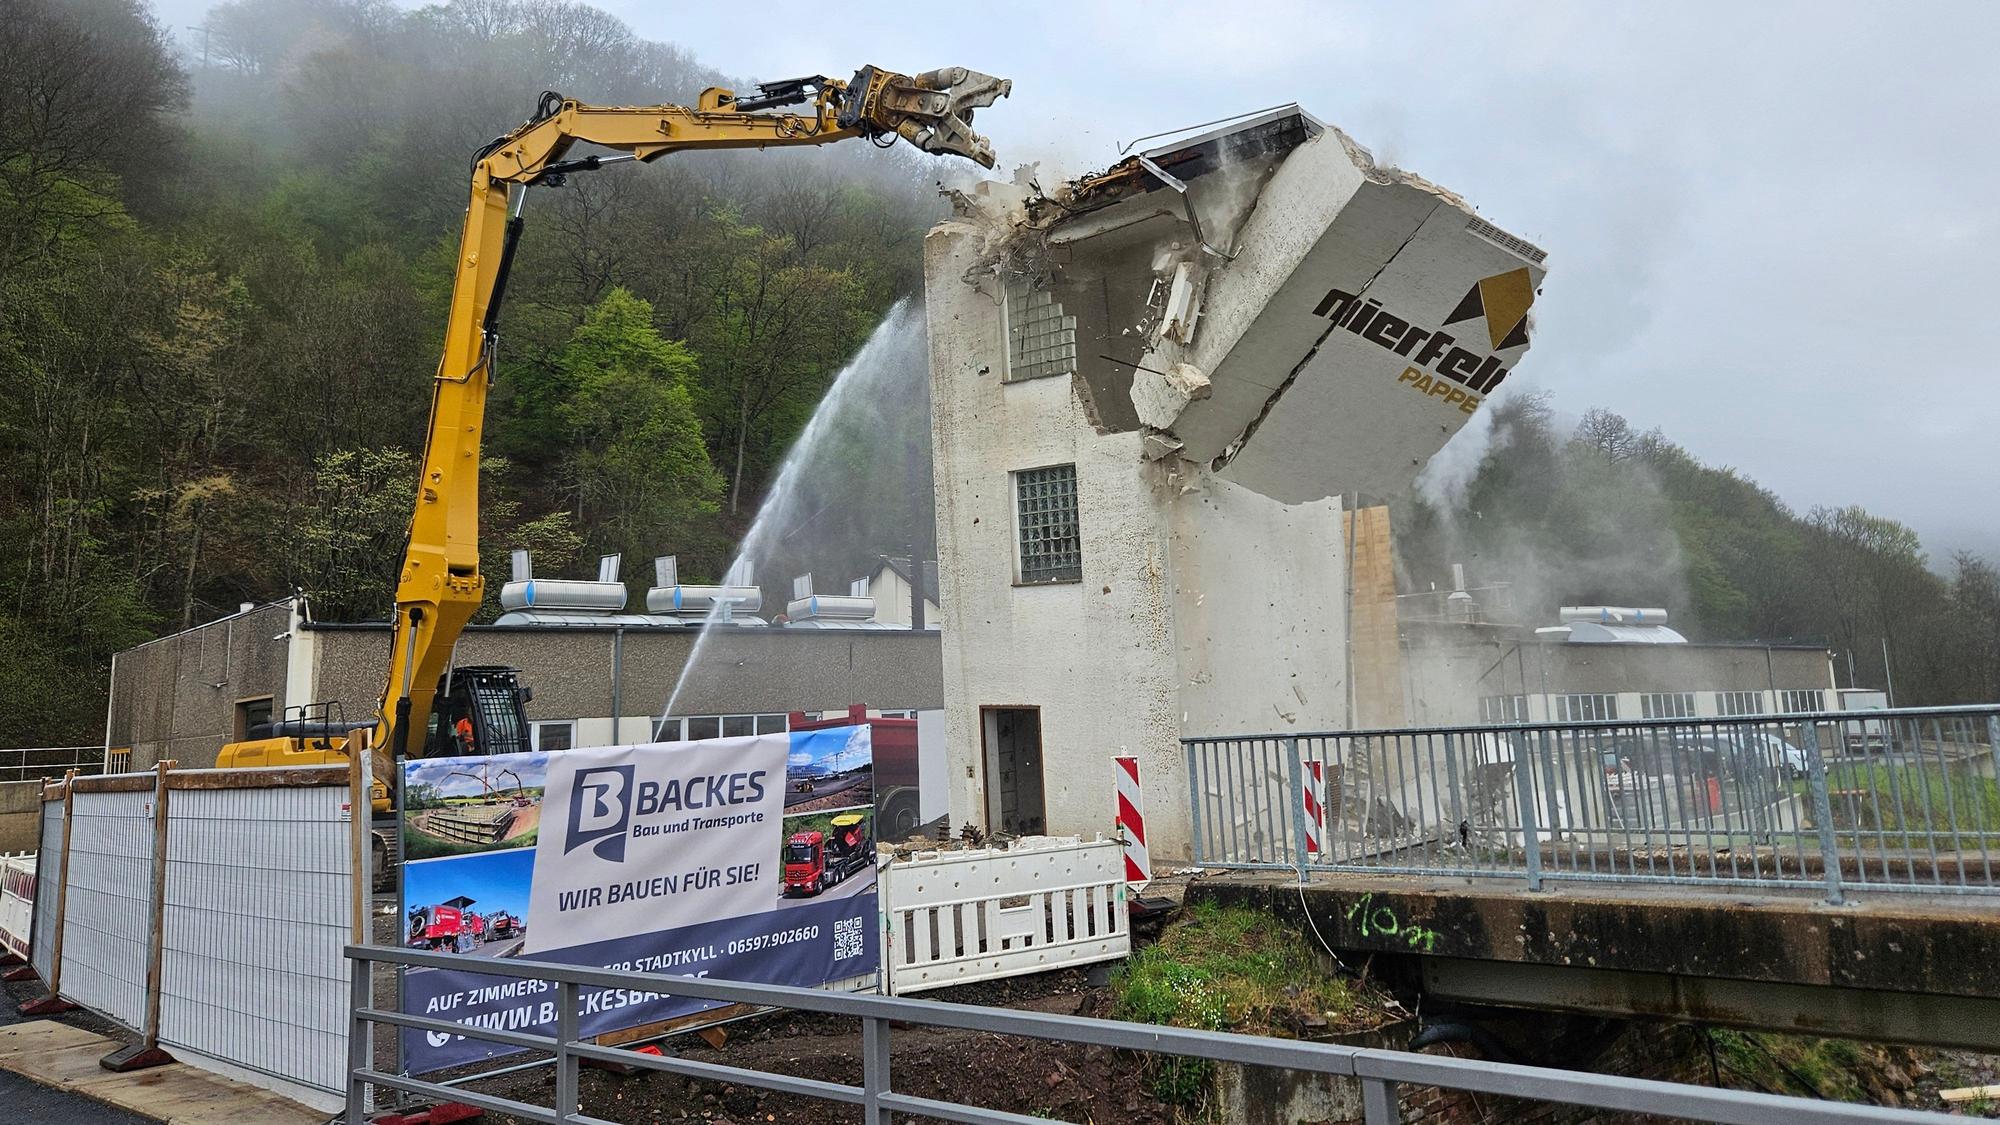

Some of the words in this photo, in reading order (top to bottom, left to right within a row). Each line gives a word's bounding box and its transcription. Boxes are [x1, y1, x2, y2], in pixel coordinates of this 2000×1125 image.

[635, 770, 766, 815] BACKES
[633, 824, 659, 838] Bau
[663, 819, 689, 834] und
[692, 812, 764, 830] Transporte
[559, 887, 602, 912] WIR
[607, 875, 678, 904] BAUEN
[683, 866, 721, 893] FÜR
[726, 863, 760, 886] SIE!
[426, 992, 464, 1014] AUF
[466, 979, 548, 1006] ZIMMERS
[635, 945, 717, 972] STADTKYLL
[728, 925, 818, 956] 06597.902660
